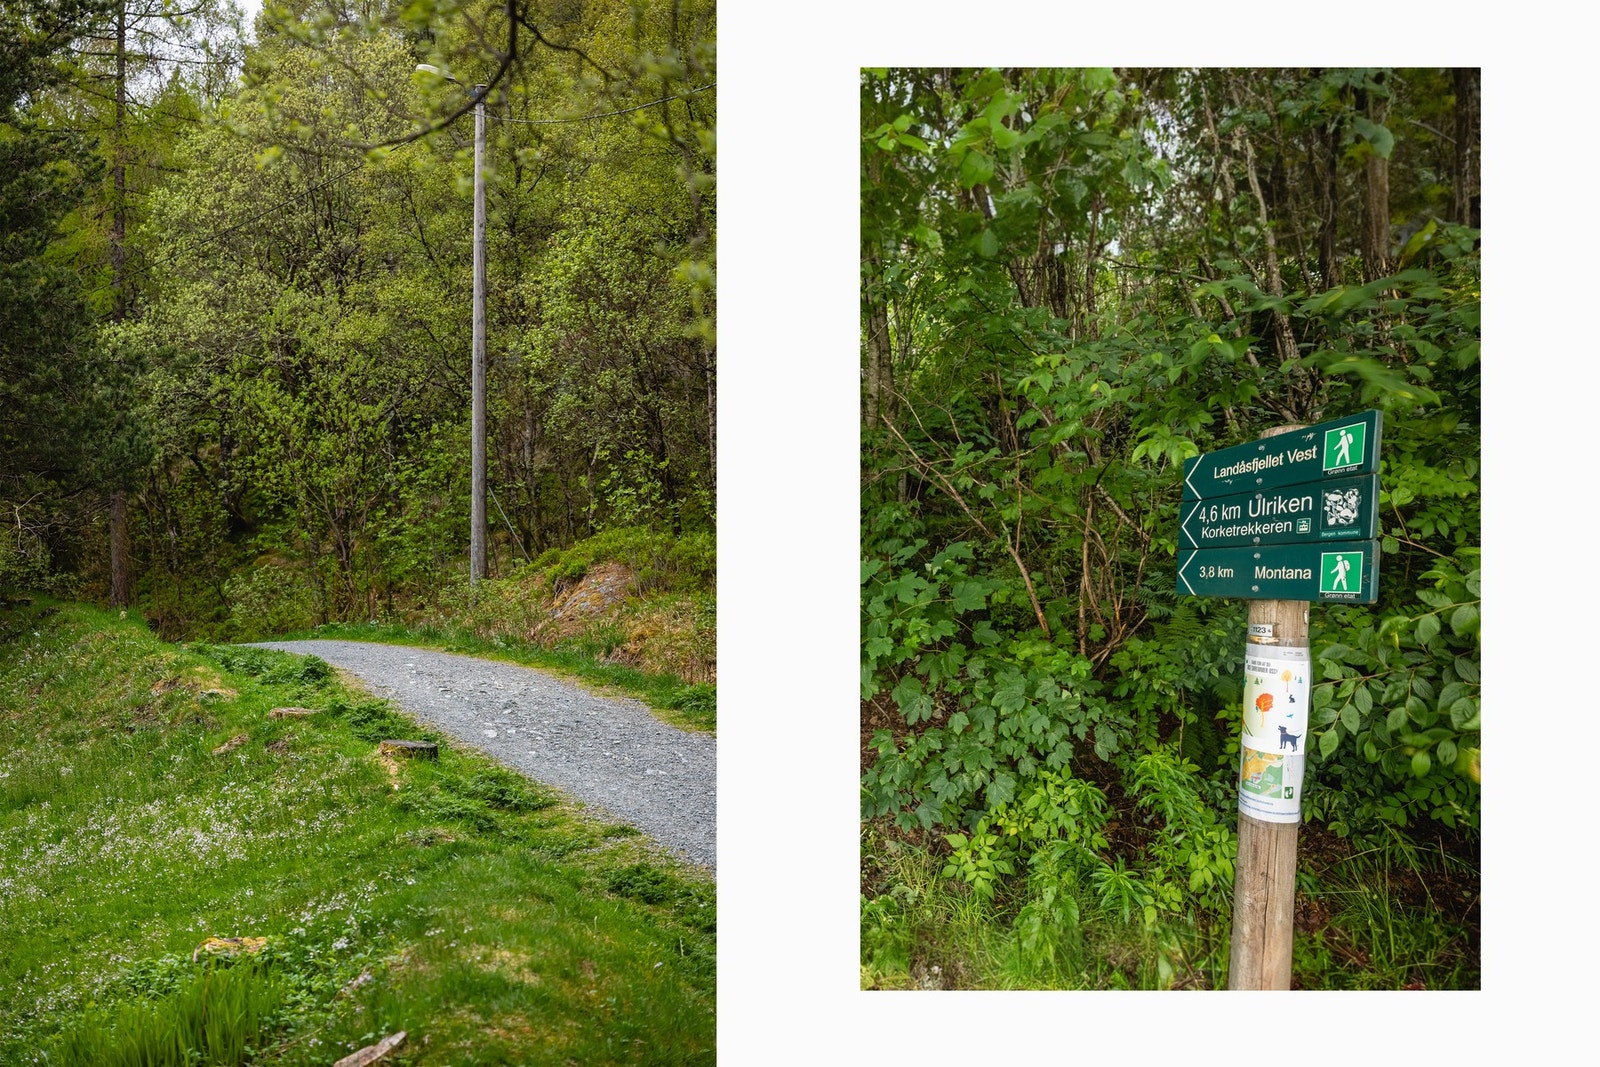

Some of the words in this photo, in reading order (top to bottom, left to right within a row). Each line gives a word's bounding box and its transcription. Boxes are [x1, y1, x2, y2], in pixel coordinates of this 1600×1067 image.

[1214, 452, 1284, 479] Landåsfjellet
[1287, 445, 1317, 464] Vest
[1199, 505, 1218, 523] 4,6
[1222, 503, 1241, 521] km
[1248, 495, 1313, 518] Ulriken
[1201, 520, 1292, 539] Korketrekkeren
[1199, 566, 1215, 580] 3,8
[1217, 565, 1234, 578] km
[1254, 566, 1312, 580] Montana
